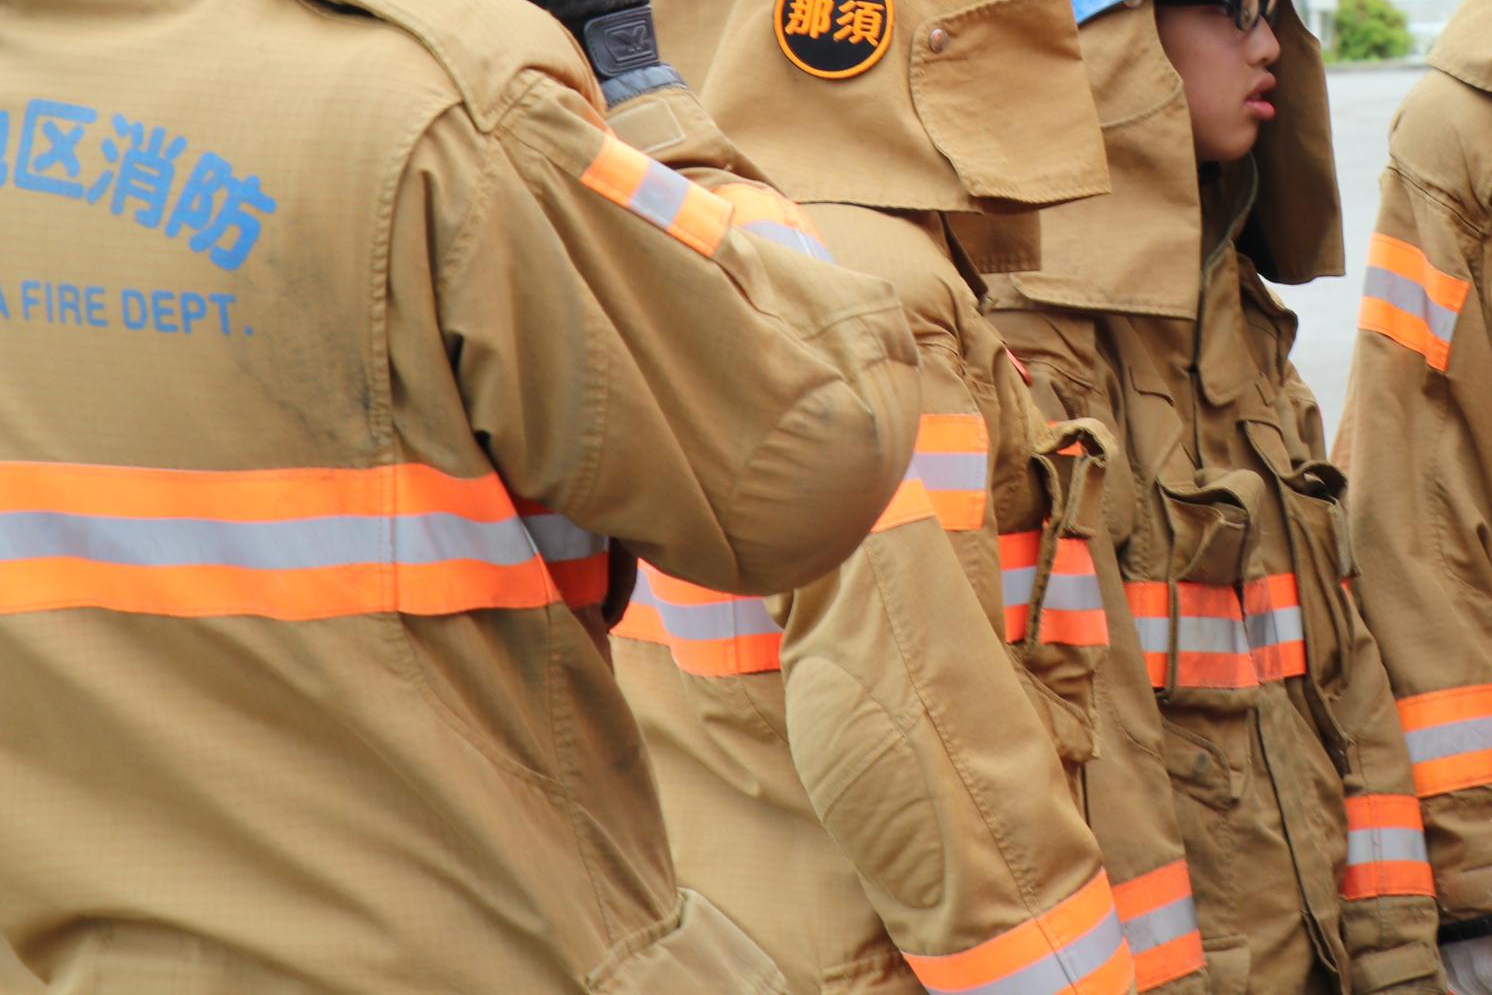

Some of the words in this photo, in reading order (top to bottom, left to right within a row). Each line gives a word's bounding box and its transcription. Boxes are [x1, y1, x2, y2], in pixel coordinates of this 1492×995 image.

[0, 98, 277, 272] 区消防
[20, 280, 108, 327] FIRE
[121, 289, 254, 336] DEPT.
